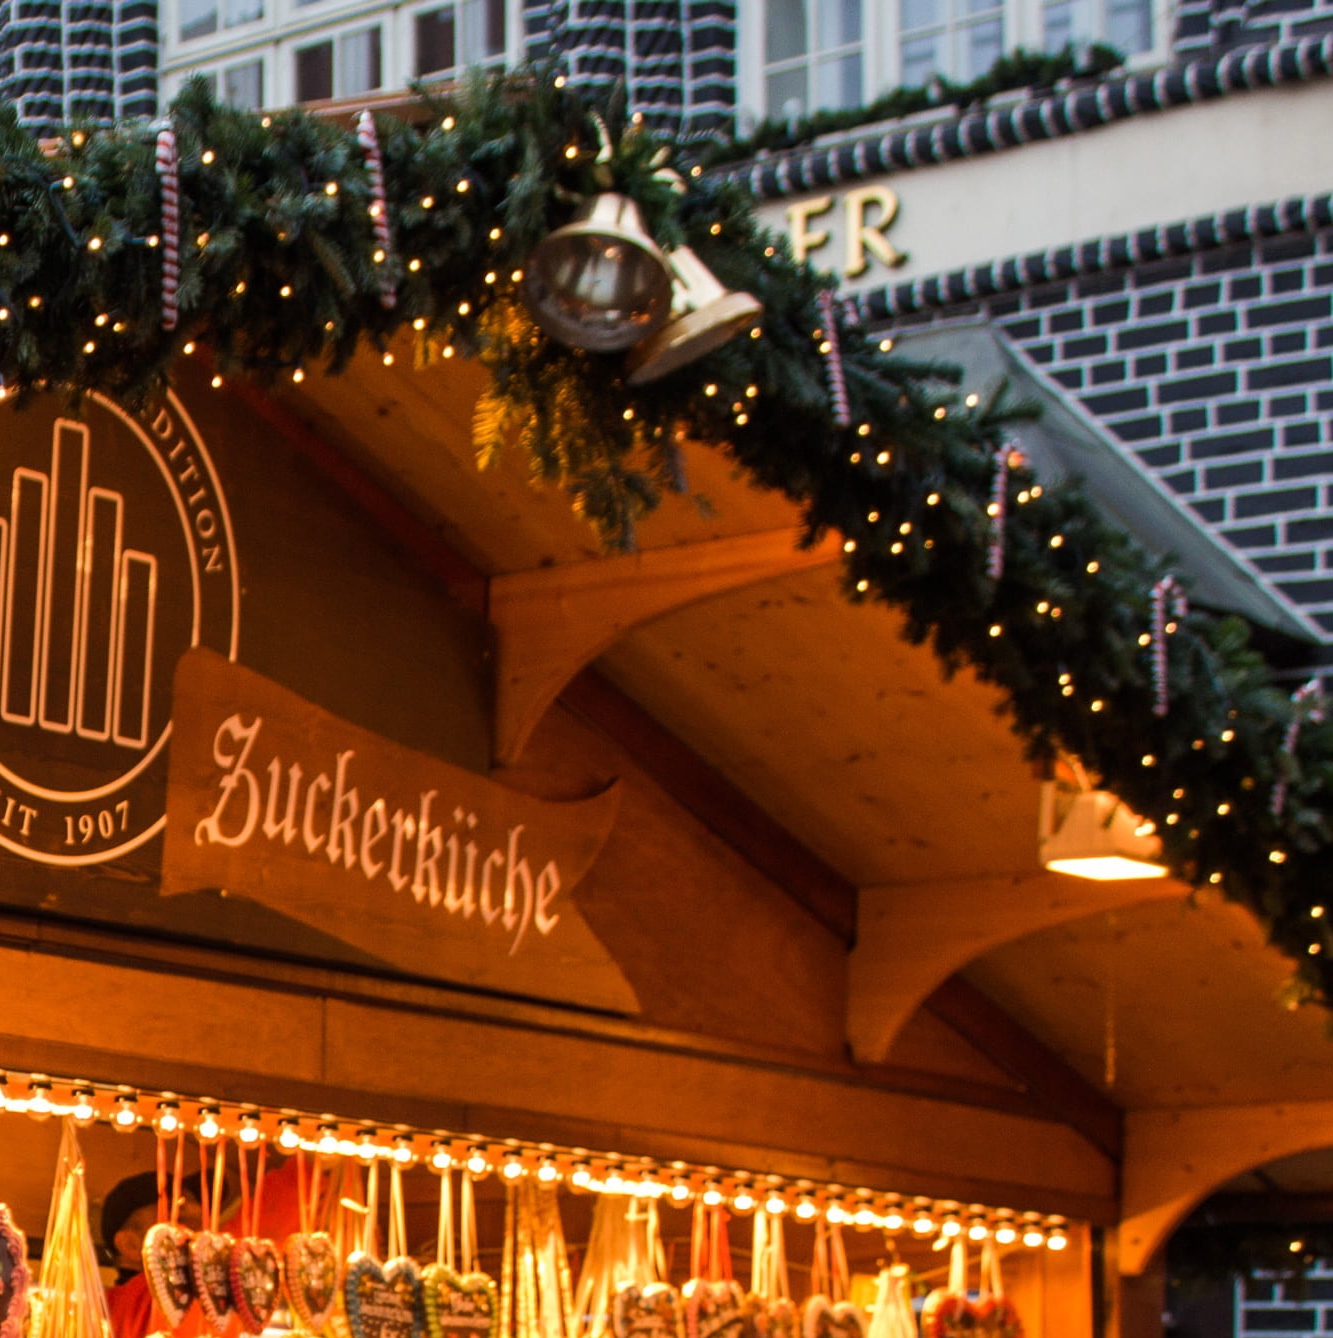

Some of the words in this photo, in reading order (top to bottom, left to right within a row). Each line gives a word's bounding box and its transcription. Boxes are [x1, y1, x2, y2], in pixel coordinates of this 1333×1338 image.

[150, 406, 223, 574] DITION
[63, 800, 130, 846] 1907
[194, 714, 561, 955] Zuckerküche
